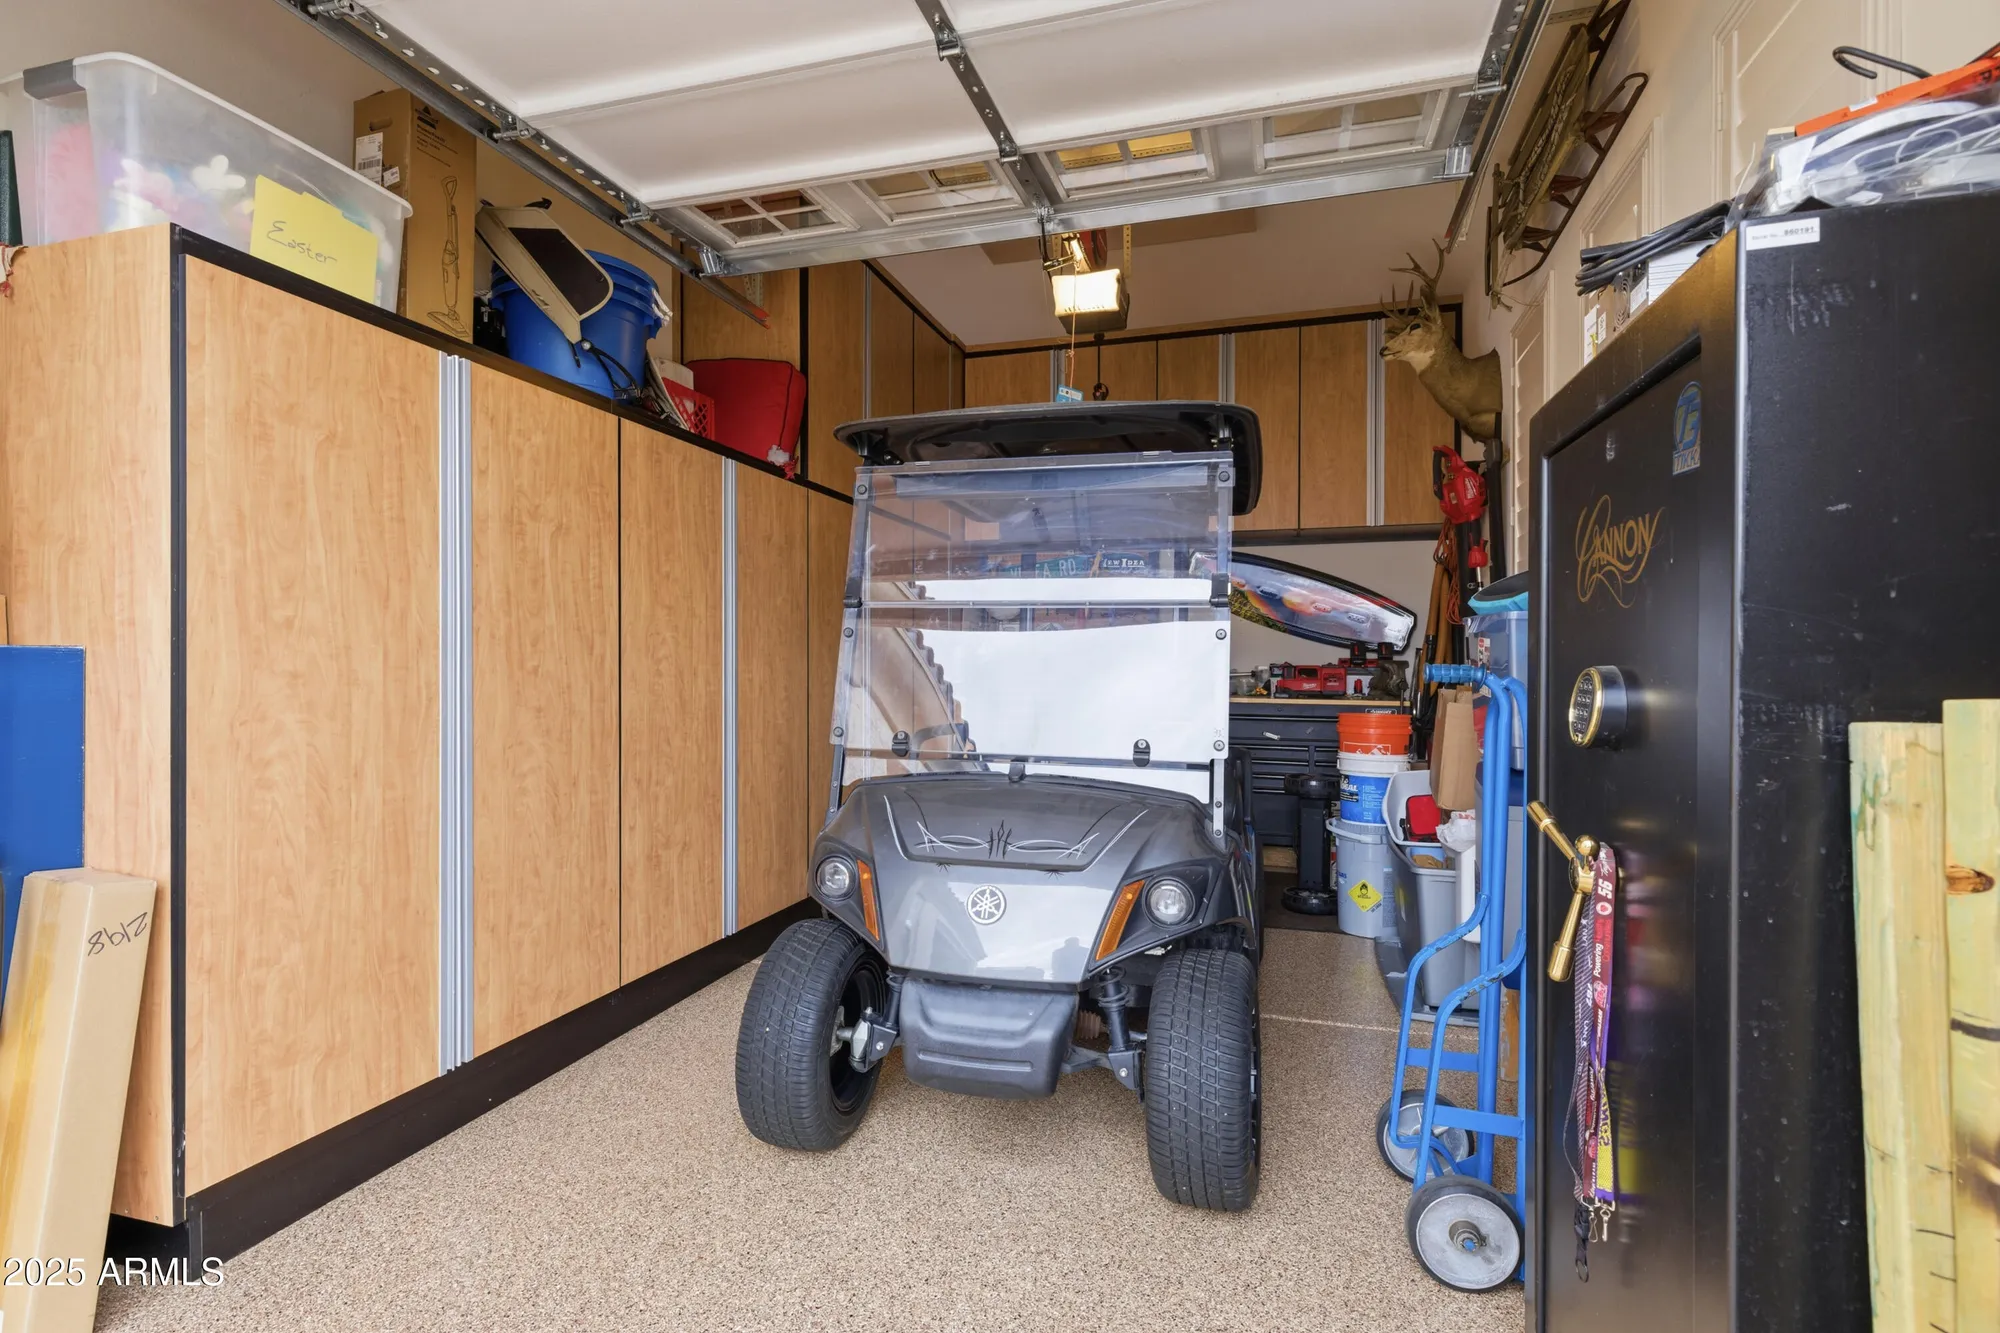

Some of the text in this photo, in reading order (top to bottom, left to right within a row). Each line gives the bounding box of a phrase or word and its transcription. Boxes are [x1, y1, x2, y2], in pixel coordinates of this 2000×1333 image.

[266, 220, 338, 263] Easter
[1598, 878, 1613, 899] 56
[1593, 943, 1603, 977] Powering
